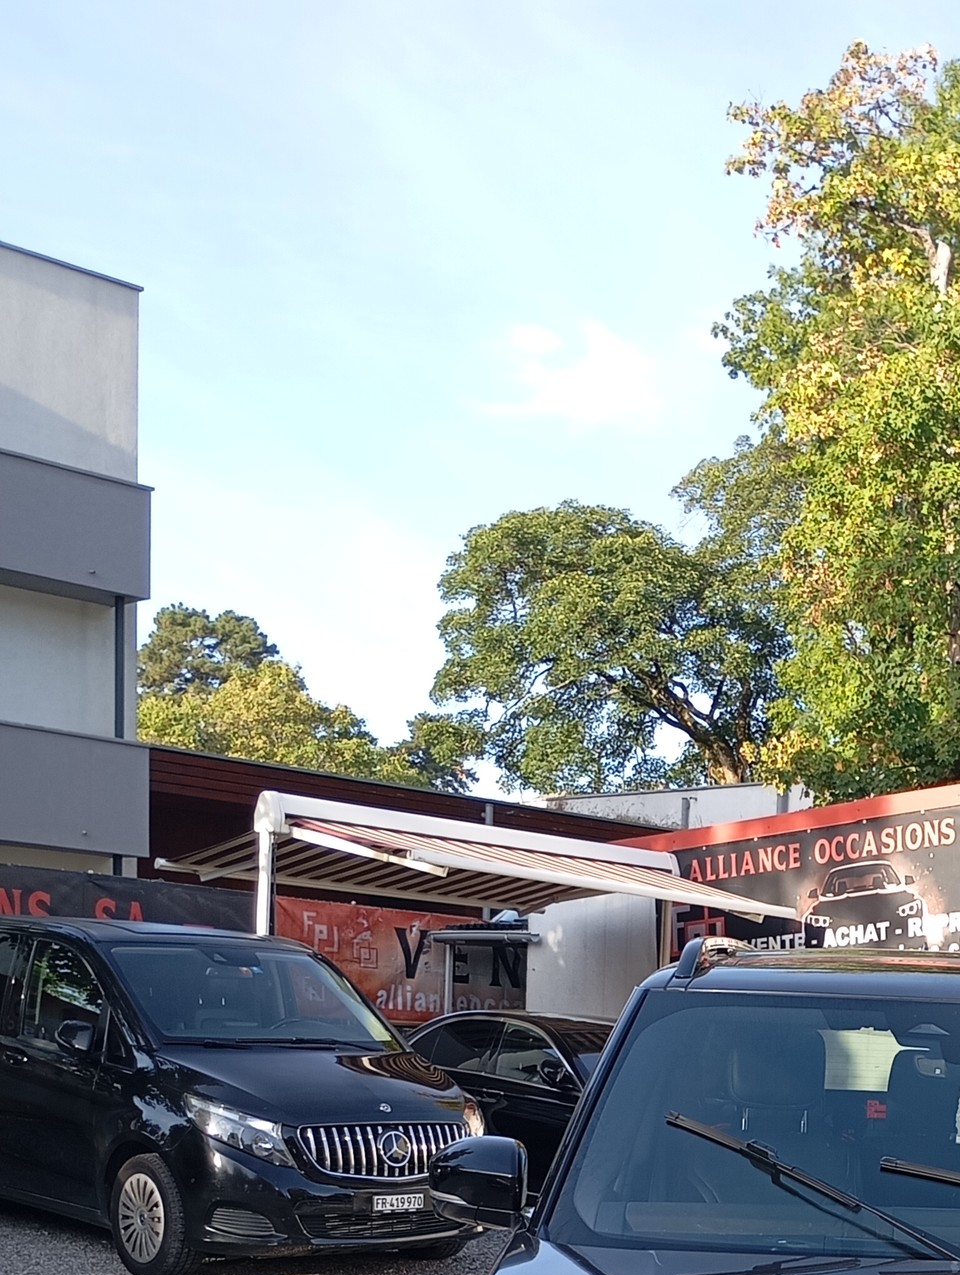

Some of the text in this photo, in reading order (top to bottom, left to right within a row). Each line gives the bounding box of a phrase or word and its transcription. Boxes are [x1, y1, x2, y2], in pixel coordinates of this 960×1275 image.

[689, 842, 801, 883] ALLIANCE
[813, 817, 956, 865] OCCASIONS
[823, 921, 890, 948] ACHAT
